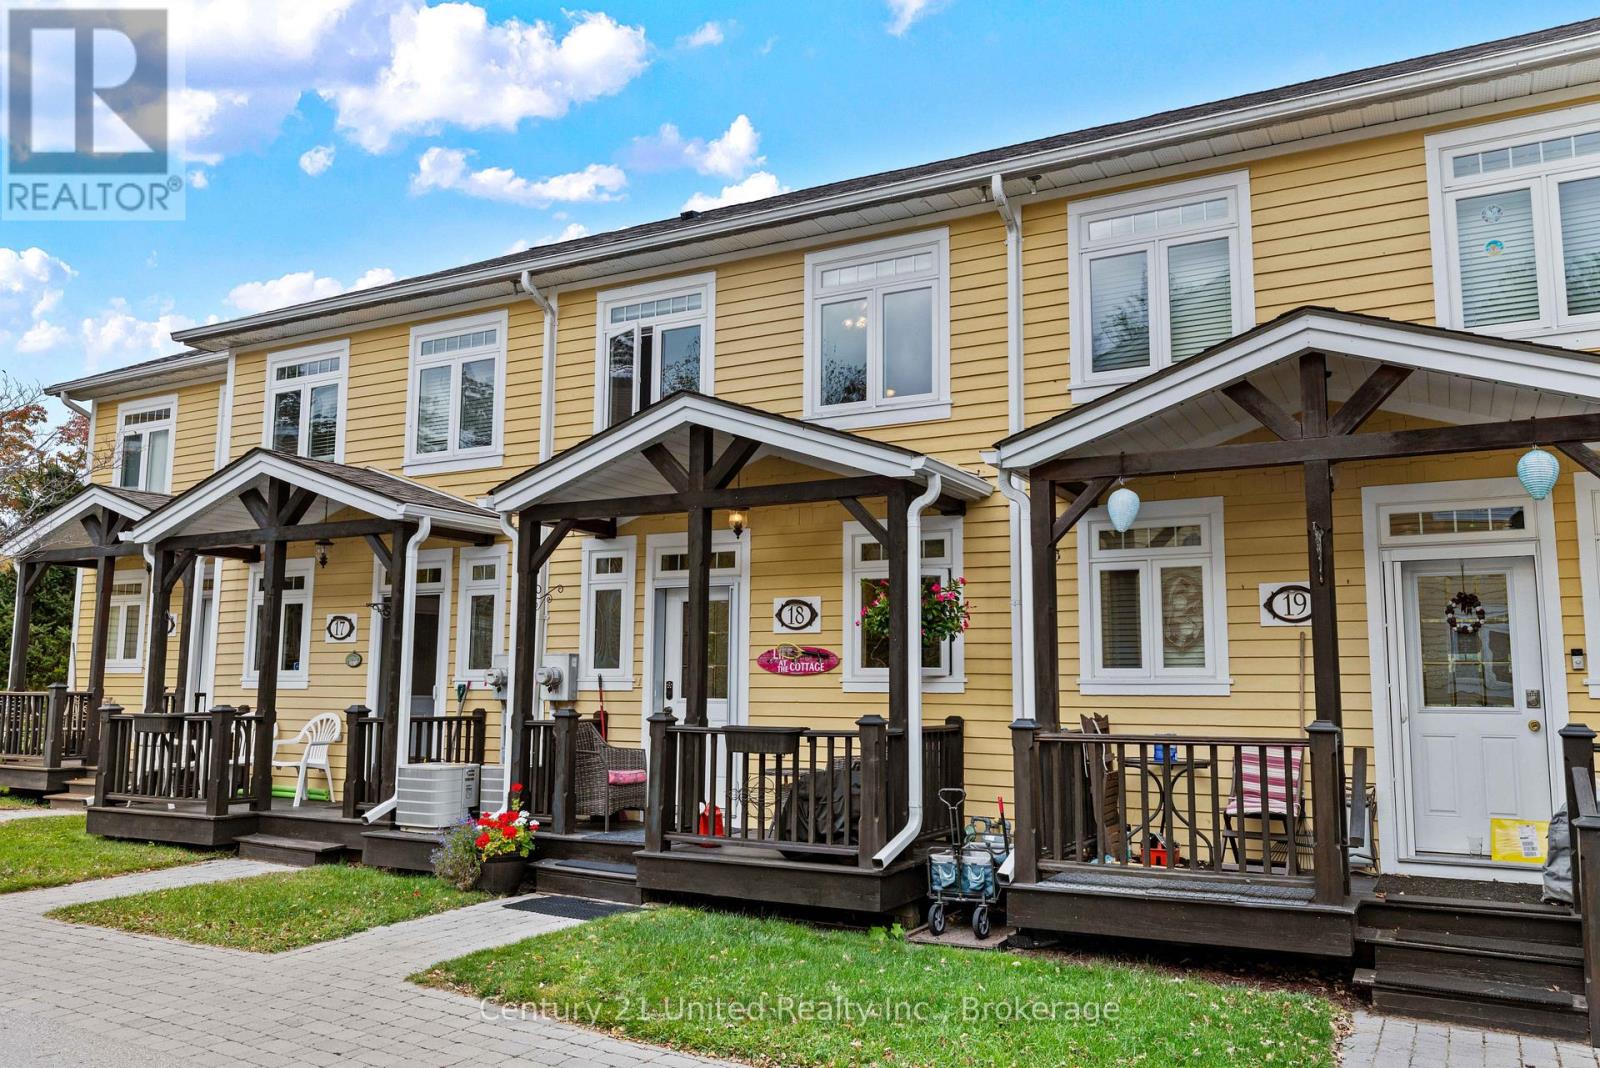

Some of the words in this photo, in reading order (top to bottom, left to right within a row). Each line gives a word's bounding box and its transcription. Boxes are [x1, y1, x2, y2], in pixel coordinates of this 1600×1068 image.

[1283, 593, 1306, 616] 19
[788, 605, 805, 624] 18
[335, 620, 345, 635] 17
[789, 662, 824, 672] COTTAGE
